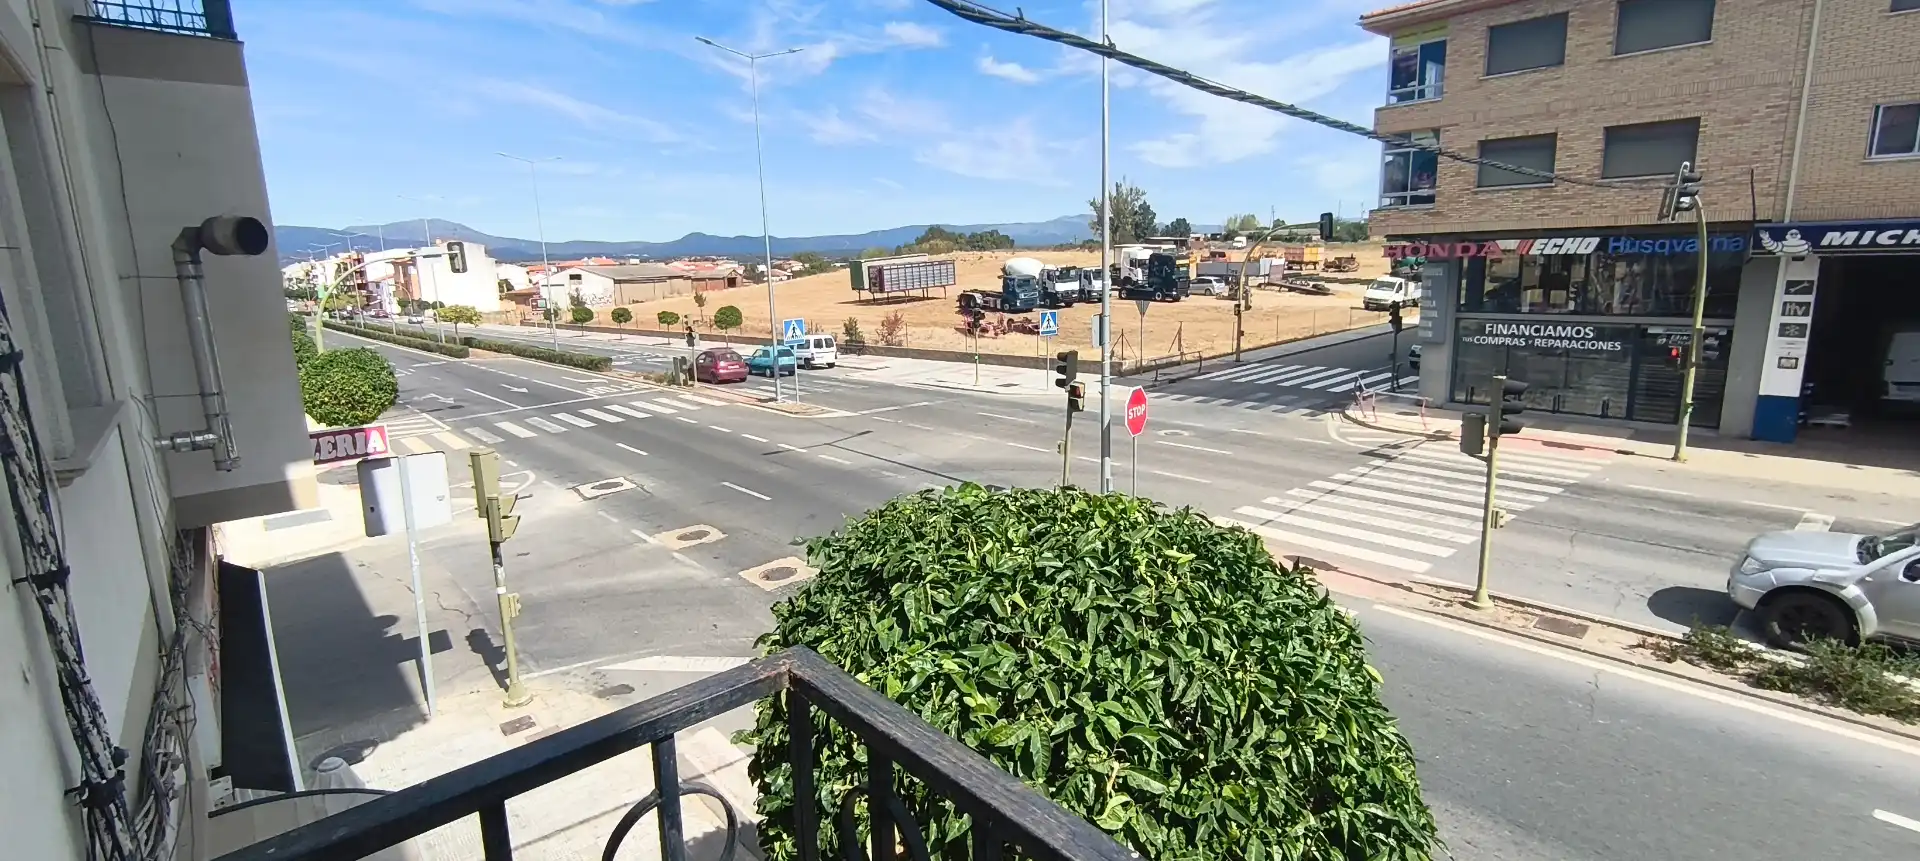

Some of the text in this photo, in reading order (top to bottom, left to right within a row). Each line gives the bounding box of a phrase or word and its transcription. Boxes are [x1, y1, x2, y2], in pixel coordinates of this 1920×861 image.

[1382, 241, 1503, 258] HONDA
[1530, 237, 1600, 255] ECHO
[1485, 323, 1595, 339] FINANCIAMOS
[1474, 335, 1526, 347] COMPRAS
[1534, 338, 1622, 351] REPARACIONES
[1128, 404, 1146, 420] STOP
